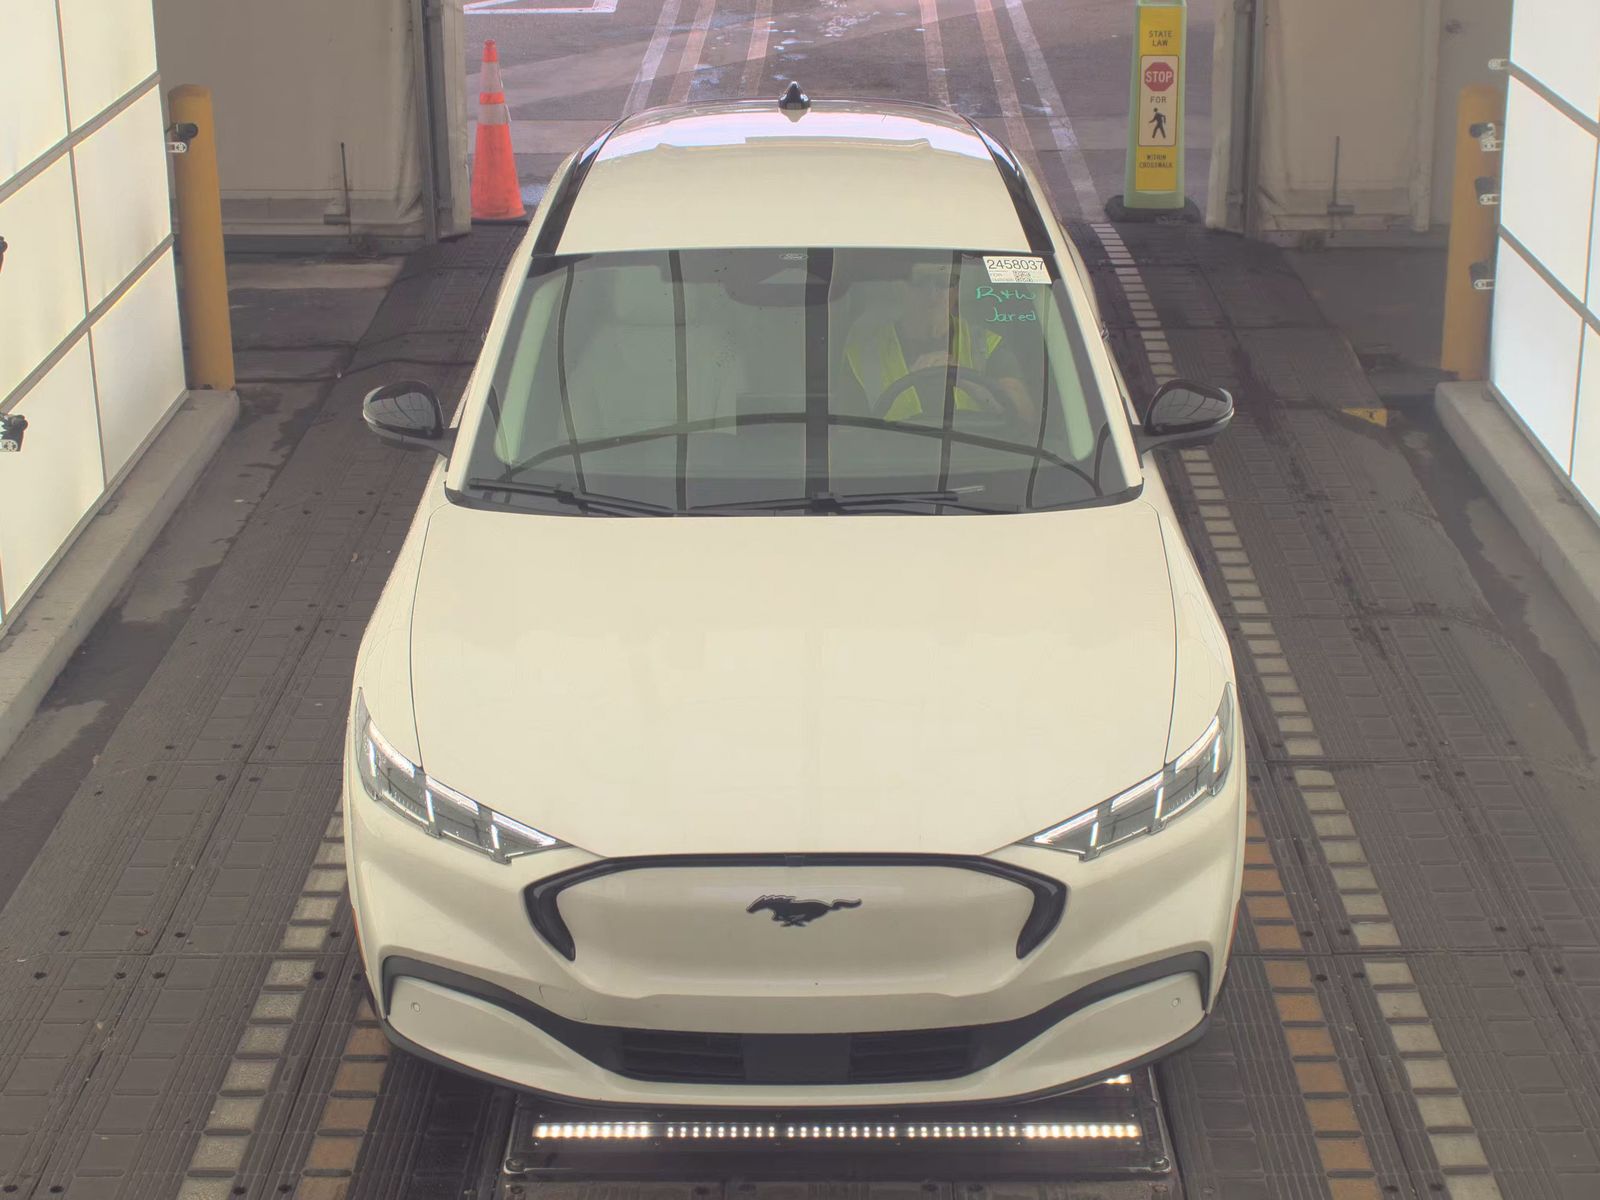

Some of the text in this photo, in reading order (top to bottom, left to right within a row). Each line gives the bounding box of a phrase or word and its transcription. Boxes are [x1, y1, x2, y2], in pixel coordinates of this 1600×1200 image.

[1148, 30, 1173, 38] STATE
[1152, 39, 1169, 47] LAW
[1145, 70, 1173, 83] STOP
[1150, 96, 1167, 104] FOR
[987, 259, 1044, 270] 2458037
[985, 306, 1037, 322] Jared
